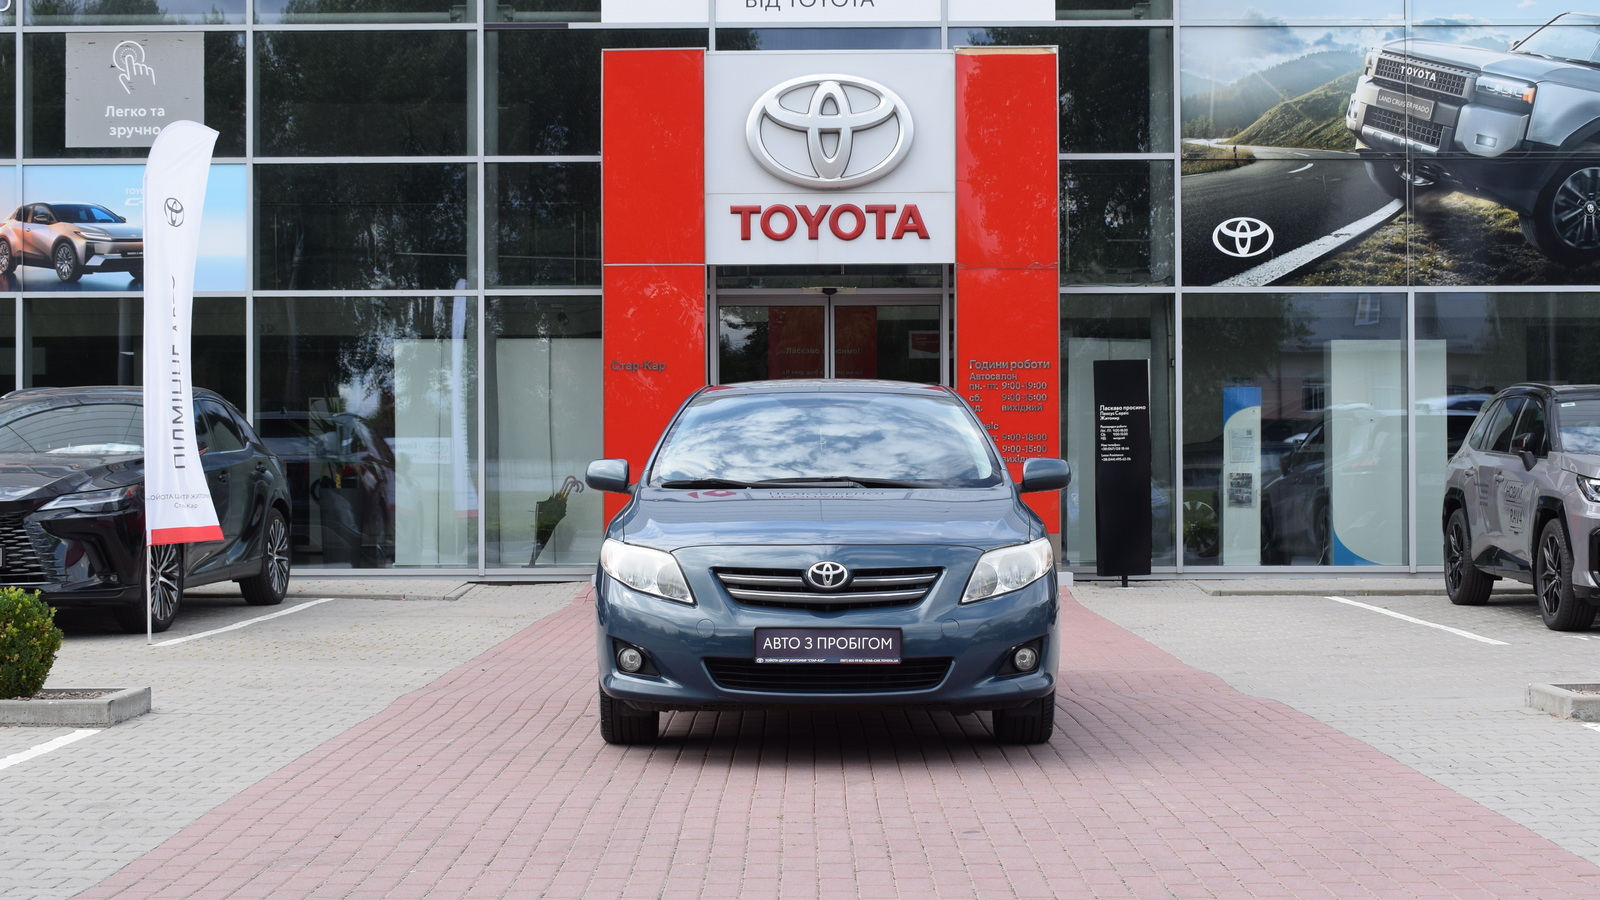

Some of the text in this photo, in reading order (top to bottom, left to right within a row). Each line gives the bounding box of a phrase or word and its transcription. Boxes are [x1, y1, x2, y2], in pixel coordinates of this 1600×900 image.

[1401, 66, 1436, 81] TOYOTA
[1378, 95, 1391, 103] LAND
[1413, 103, 1429, 113] PRADO
[105, 105, 165, 117] Легко та
[109, 127, 161, 138] зручно
[730, 203, 930, 241] TOYOTA
[611, 360, 667, 372] Стар-Кар
[968, 359, 1050, 371] Години роботи
[969, 372, 1018, 380] Автосалон
[968, 393, 983, 402] сб.
[1001, 403, 1043, 412] вихідний
[762, 636, 893, 650] АВТО З ПРОБІГОМ
